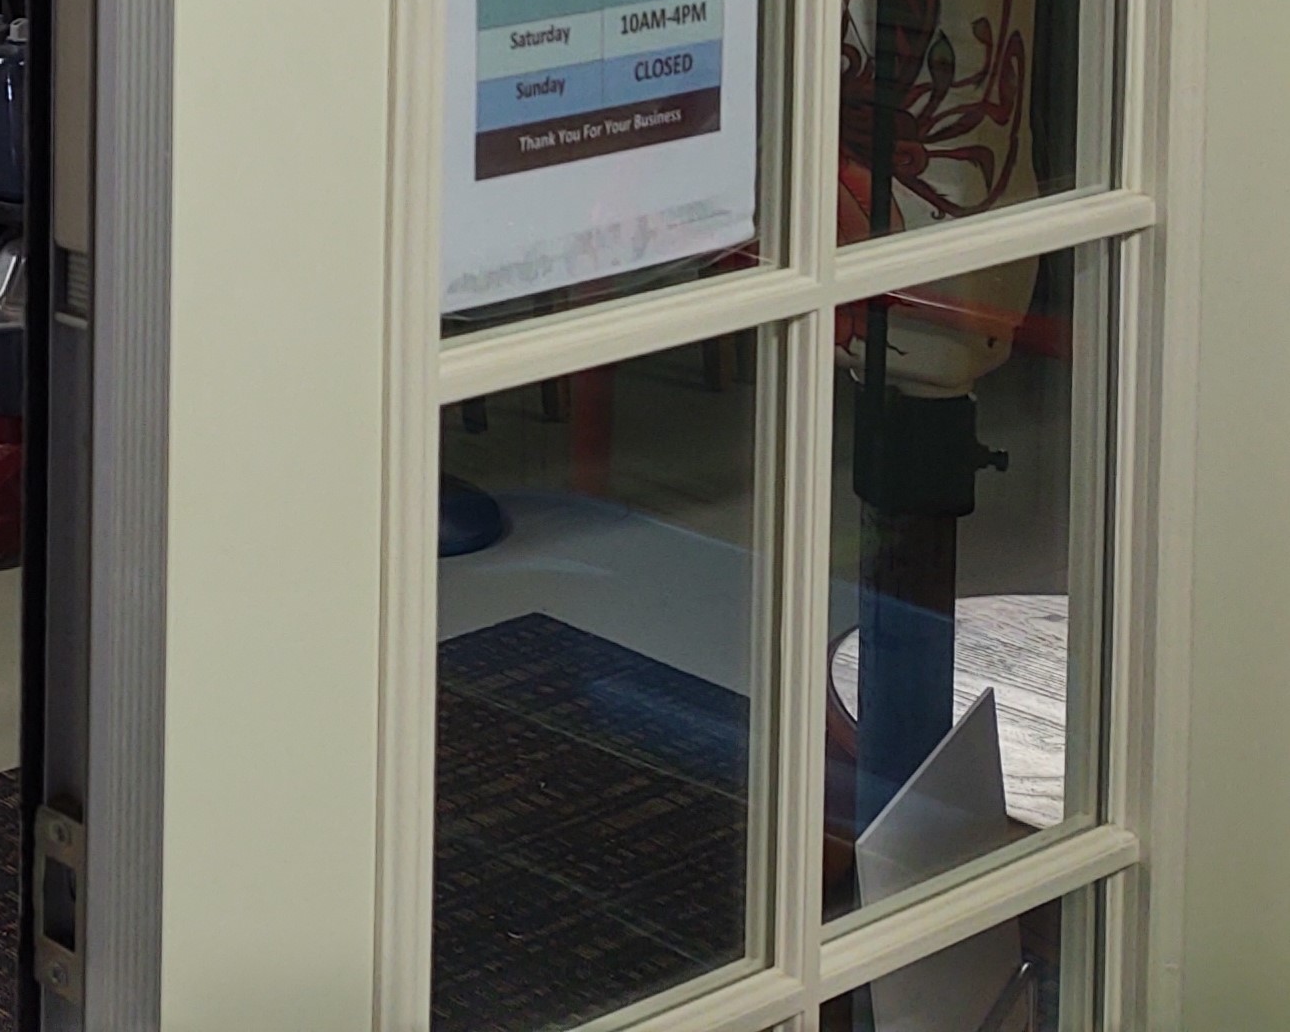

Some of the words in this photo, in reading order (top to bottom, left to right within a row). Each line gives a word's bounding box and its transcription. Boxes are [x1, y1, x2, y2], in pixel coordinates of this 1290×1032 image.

[510, 26, 571, 50] Saturday
[620, 1, 707, 36] 10AM-4PM
[516, 76, 566, 100] Sunday
[634, 52, 694, 82] CLOSED
[519, 131, 557, 153] Thank
[558, 127, 582, 146] You
[582, 123, 602, 139] For
[604, 117, 630, 135] Your
[633, 107, 683, 130] Business
